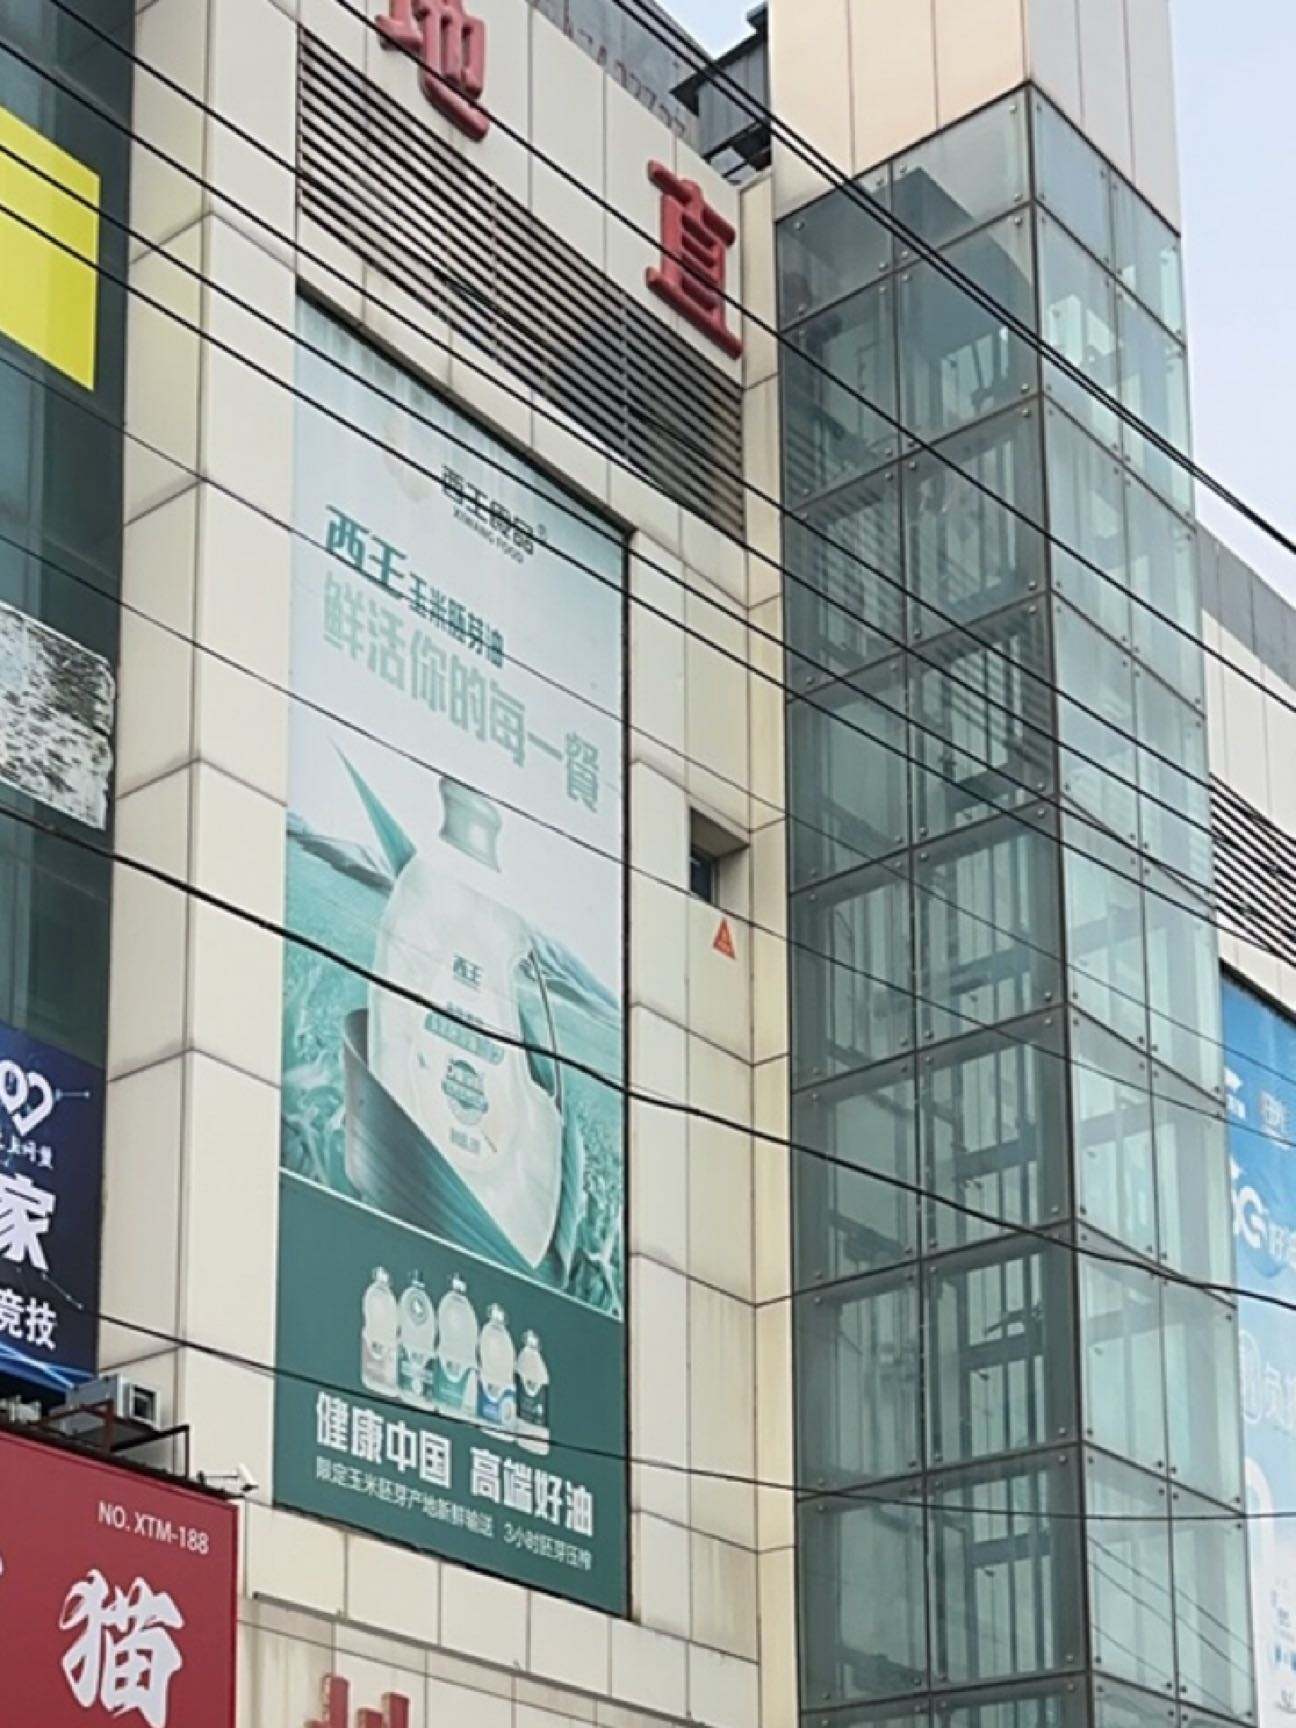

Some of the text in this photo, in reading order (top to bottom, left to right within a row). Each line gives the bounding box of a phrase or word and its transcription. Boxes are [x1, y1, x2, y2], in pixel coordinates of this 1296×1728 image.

[316, 1392, 593, 1537] 健康中国 高端好油
[135, 1511, 210, 1555] XTM-188
